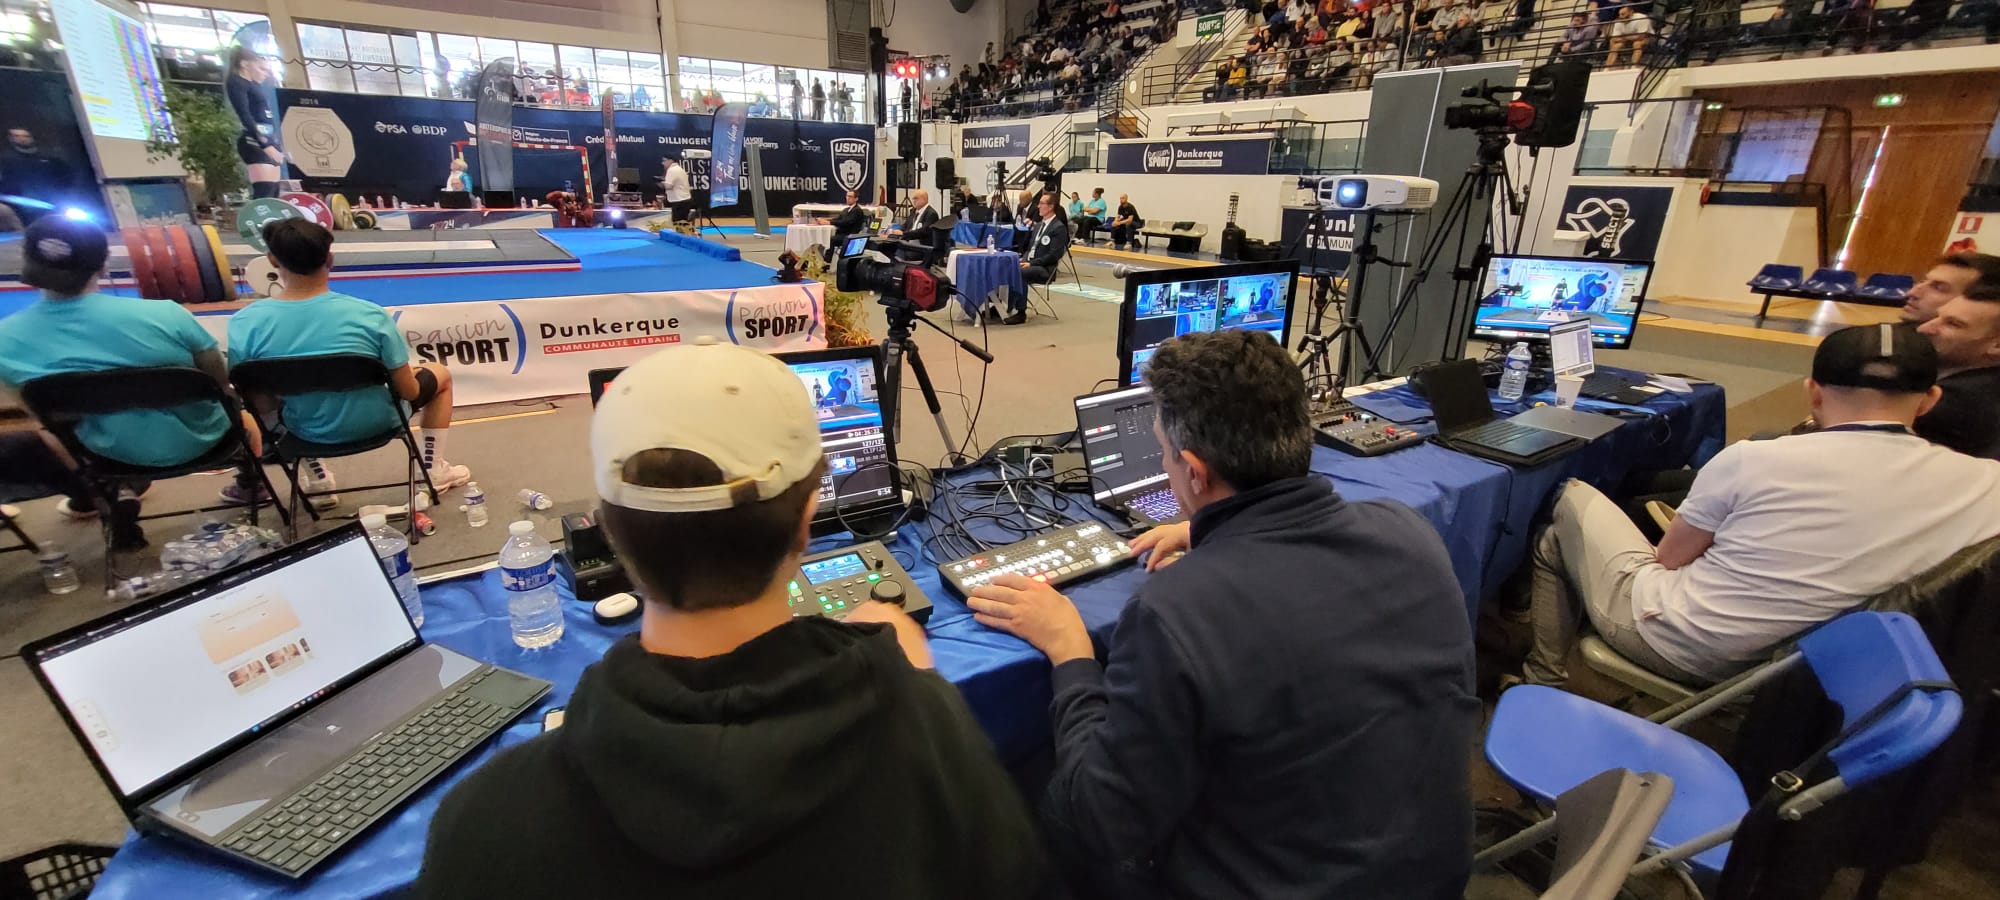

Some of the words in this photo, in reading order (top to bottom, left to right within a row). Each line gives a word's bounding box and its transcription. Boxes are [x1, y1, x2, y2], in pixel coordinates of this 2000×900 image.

[387, 125, 407, 134] PSA
[422, 126, 447, 135] BDP
[585, 135, 605, 143] Créd
[618, 134, 645, 143] Mutuel
[658, 136, 707, 145] DILLINGER
[963, 136, 1005, 149] DILLINGER
[835, 143, 866, 153] USDK
[1177, 148, 1224, 160] Dunkerque
[1148, 157, 1170, 167] SPORT
[762, 175, 828, 191] UNKERQUE
[1601, 216, 1620, 249] SELECT
[740, 299, 807, 322] passion
[406, 318, 506, 349] passion
[540, 317, 680, 340] Dunkerque
[745, 314, 809, 339] SPORT
[544, 337, 630, 353] COMMUNAUTÉ
[633, 333, 680, 345] URBAINE
[416, 337, 510, 367] SPORT
